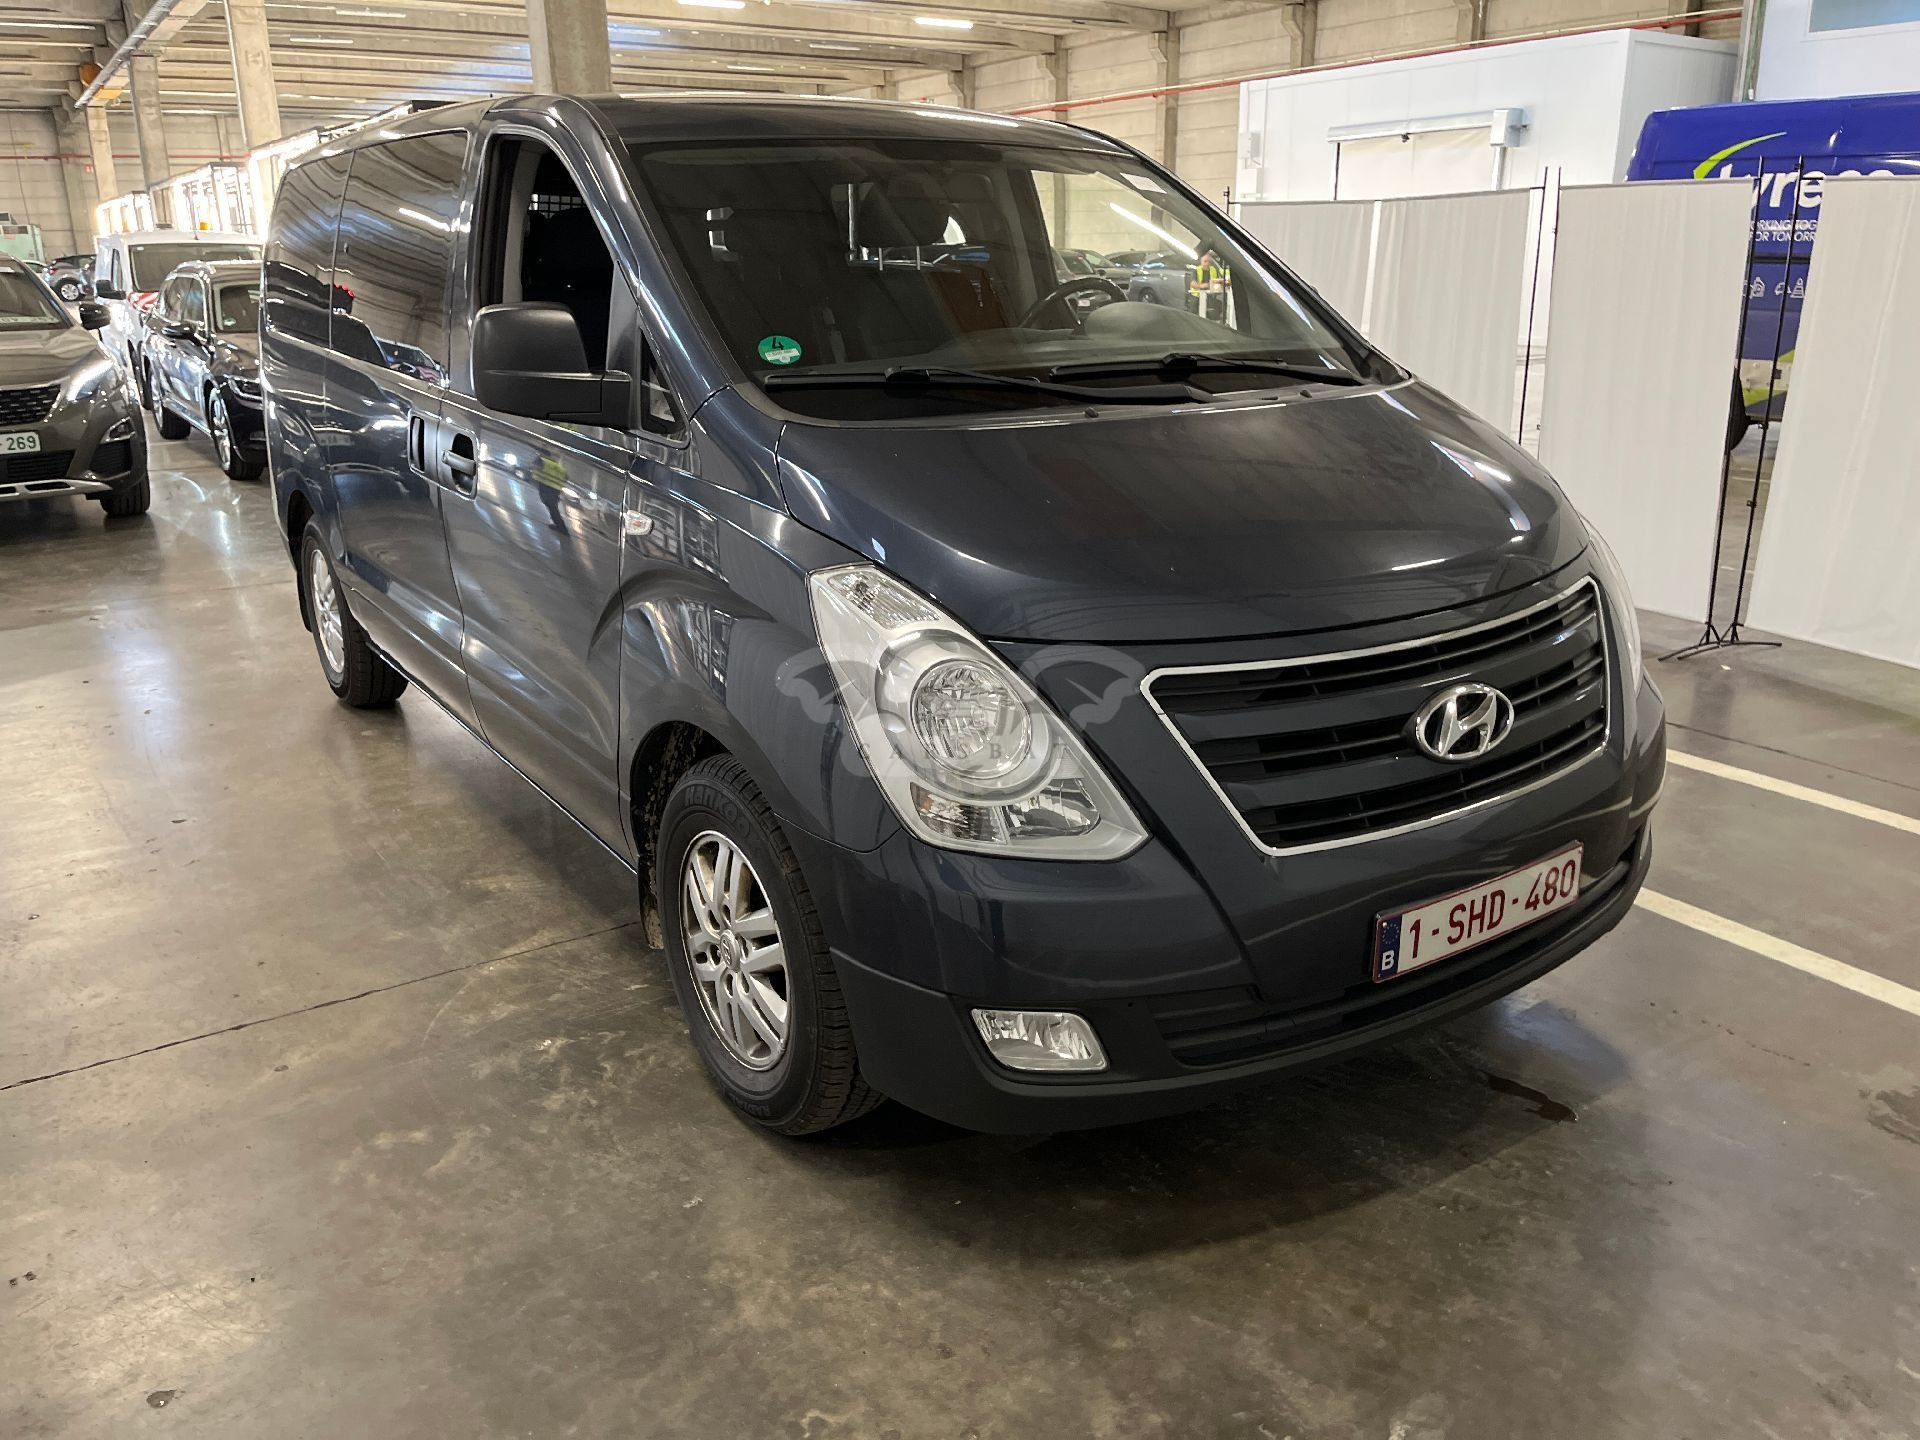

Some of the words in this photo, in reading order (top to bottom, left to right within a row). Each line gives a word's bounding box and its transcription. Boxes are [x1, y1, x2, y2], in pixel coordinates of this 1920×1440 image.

[1794, 219, 1817, 231] TOG
[1772, 231, 1816, 242] TOMORR
[1409, 859, 1576, 959] 1-SHD-480
[1381, 950, 1395, 971] B
